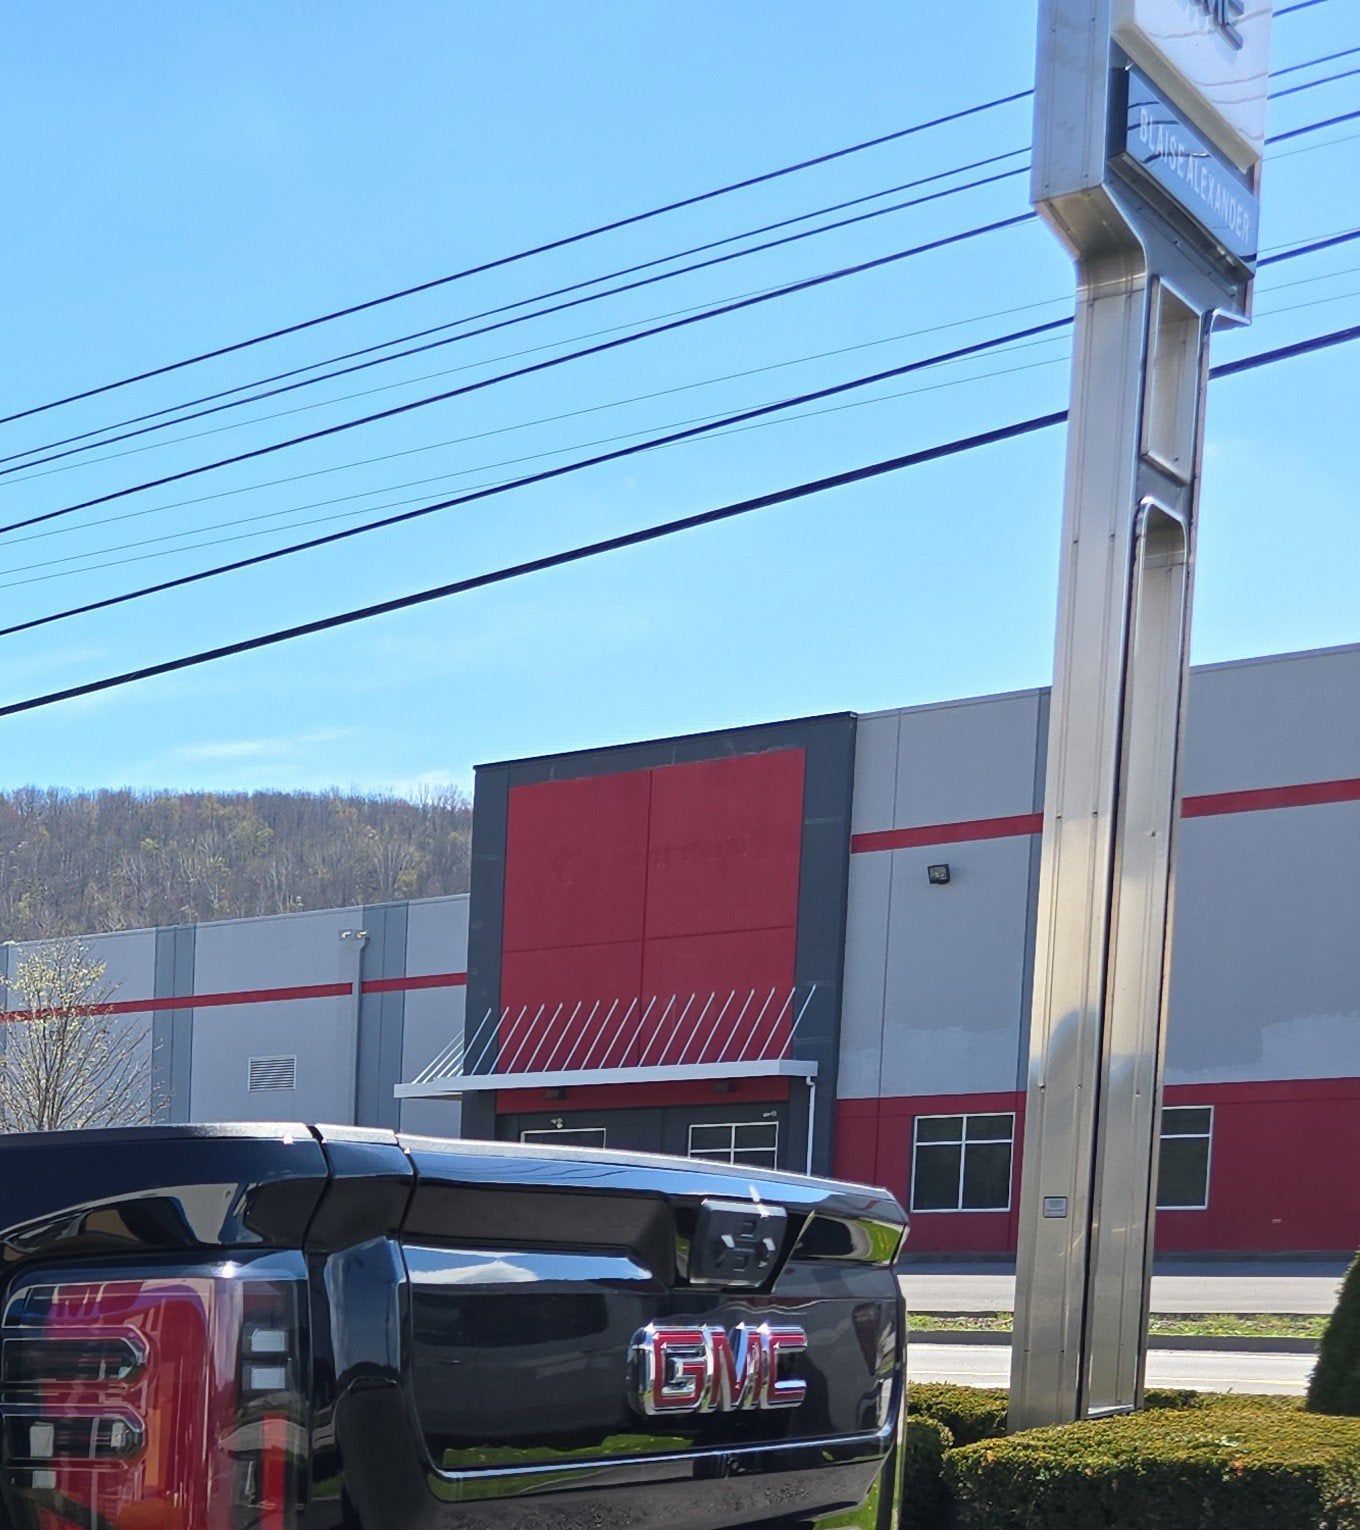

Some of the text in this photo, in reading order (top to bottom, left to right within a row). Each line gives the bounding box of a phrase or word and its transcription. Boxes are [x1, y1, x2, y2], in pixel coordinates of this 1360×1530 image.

[1139, 108, 1251, 244] BLAISE ALEXANDER
[626, 1322, 808, 1415] GMC
